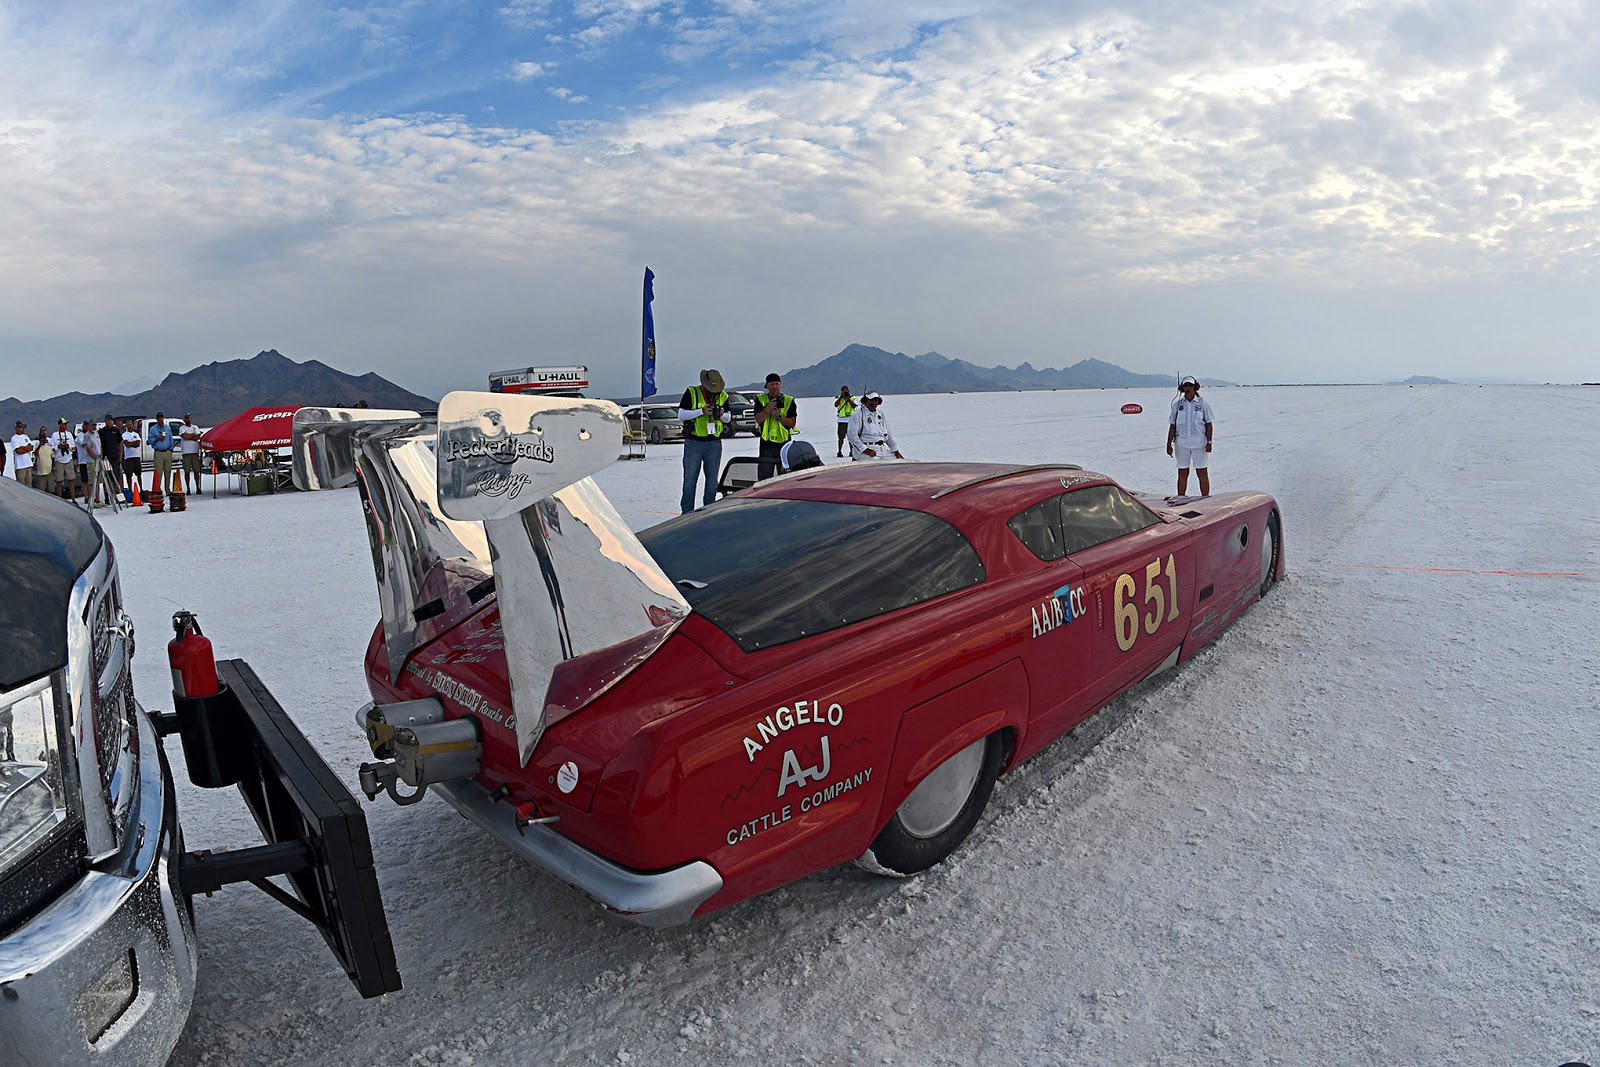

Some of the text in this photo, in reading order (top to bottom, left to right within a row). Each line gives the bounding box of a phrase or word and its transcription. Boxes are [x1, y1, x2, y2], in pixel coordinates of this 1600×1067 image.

[538, 372, 581, 382] U-HAUL
[474, 470, 532, 500] Racing
[1113, 552, 1180, 653] 651
[454, 682, 483, 713] SHOP
[478, 700, 503, 723] Rancho
[742, 699, 844, 763] ANGELO
[725, 766, 874, 846] CATTLE COMPANY
